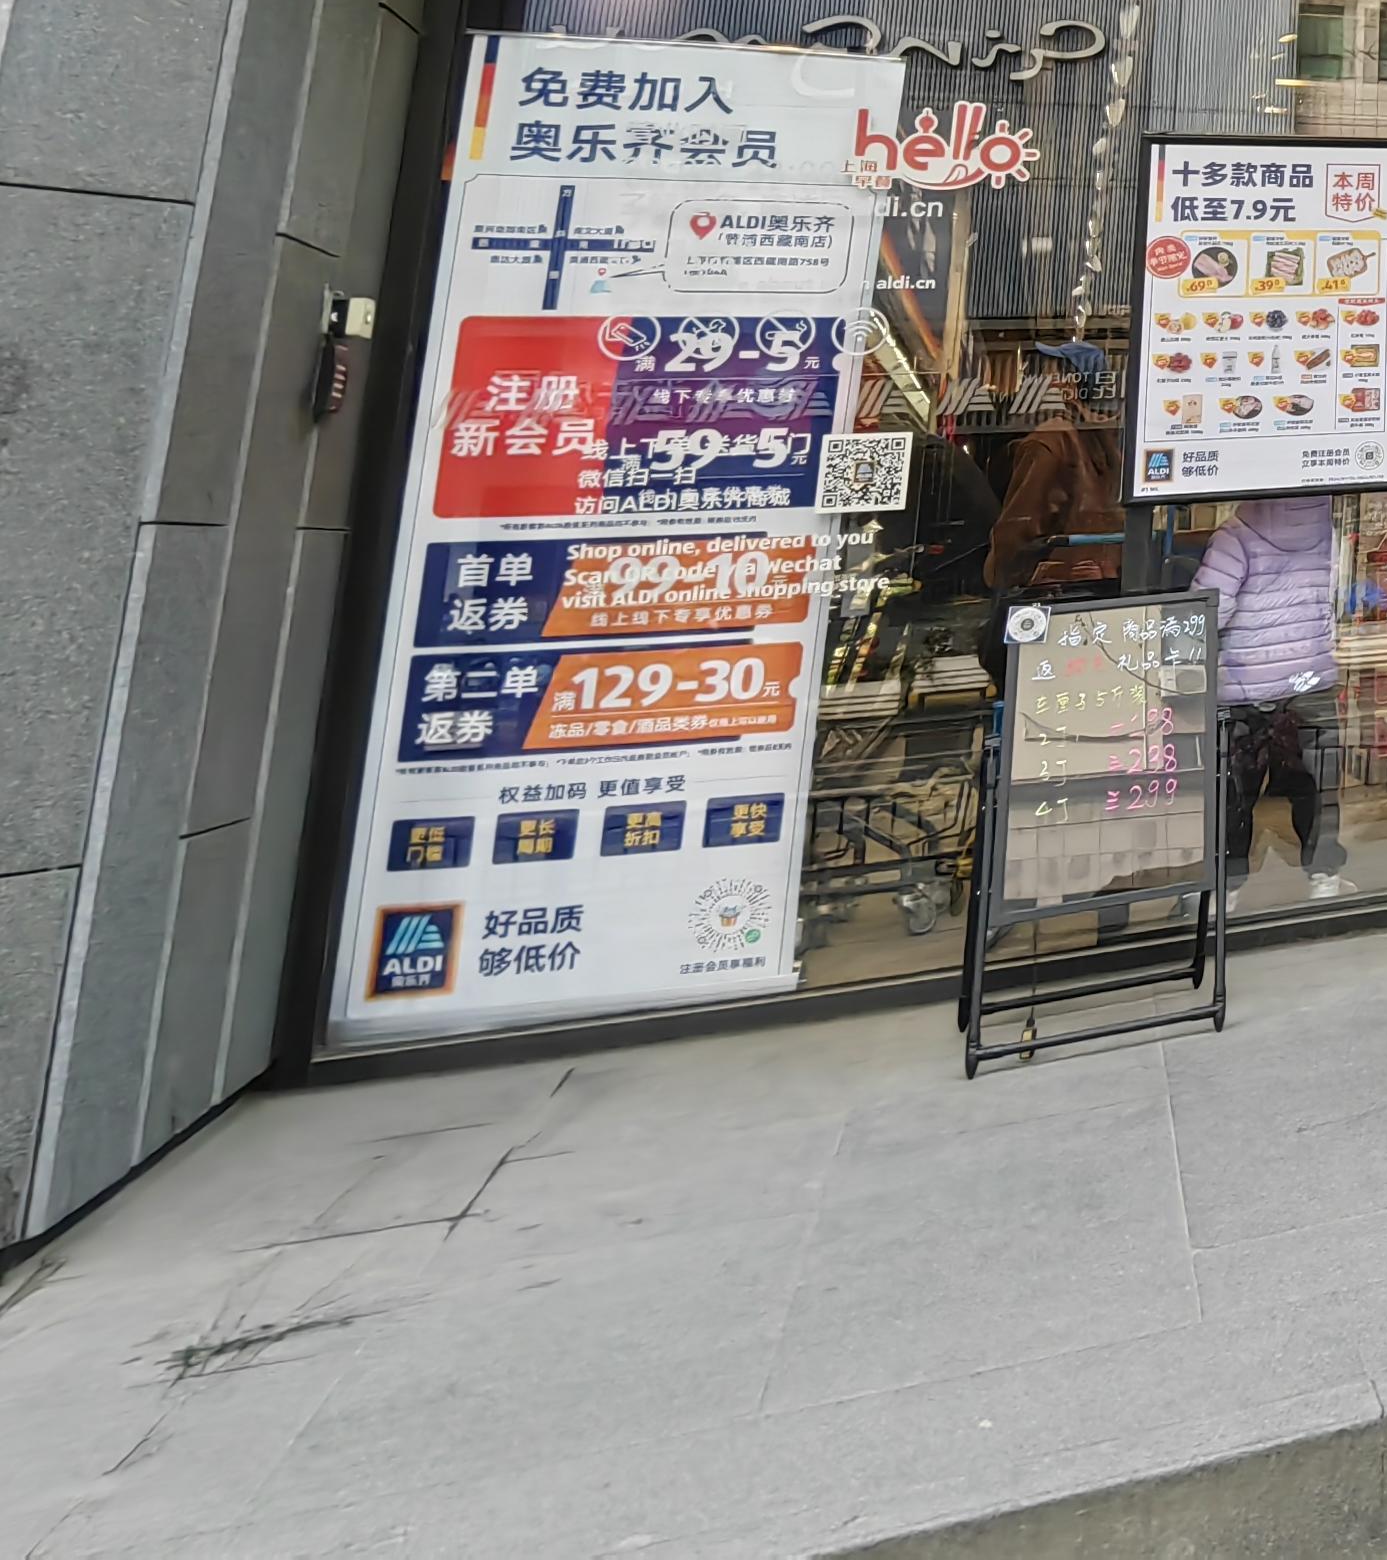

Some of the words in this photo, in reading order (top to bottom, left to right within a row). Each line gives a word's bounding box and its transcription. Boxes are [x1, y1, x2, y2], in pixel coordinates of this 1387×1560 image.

[516, 66, 734, 115] 免费加入
[509, 120, 778, 169] 奥乐齐会员
[854, 101, 1038, 176] hello
[1172, 160, 1314, 189] 十多款商品
[1332, 171, 1375, 191] 本周
[1170, 196, 1297, 223] 低至7.9元
[1331, 192, 1375, 212] 特价
[720, 214, 836, 233] ALDI奥乐齐
[876, 275, 936, 290] aldi.cn
[486, 375, 580, 413] 注册
[450, 419, 596, 458] 新会员
[1182, 450, 1219, 463] 好品质
[577, 466, 697, 489] 微信扫一扫
[1147, 467, 1169, 476] ALDI
[1181, 464, 1219, 478] 够低价
[567, 543, 622, 564] Shop
[706, 533, 806, 554] delivered
[811, 533, 829, 549] to
[837, 531, 875, 549] you
[456, 553, 534, 589] 首单
[768, 555, 842, 575] Wechat
[838, 577, 889, 594] store
[446, 597, 530, 633] 返券
[420, 663, 540, 703] 第二单
[415, 710, 494, 746] 返券
[499, 783, 587, 805] 权益加码
[598, 776, 687, 798] 更值享受
[626, 811, 662, 828] 更高
[732, 802, 767, 820] 更快
[518, 819, 555, 837] 更长
[623, 830, 660, 847] 折扣
[730, 820, 766, 838] 享受
[483, 904, 585, 940] 好品质
[382, 955, 444, 977] ALDI
[478, 942, 582, 978] 够低价
[680, 955, 767, 975] 注册会员享福利
